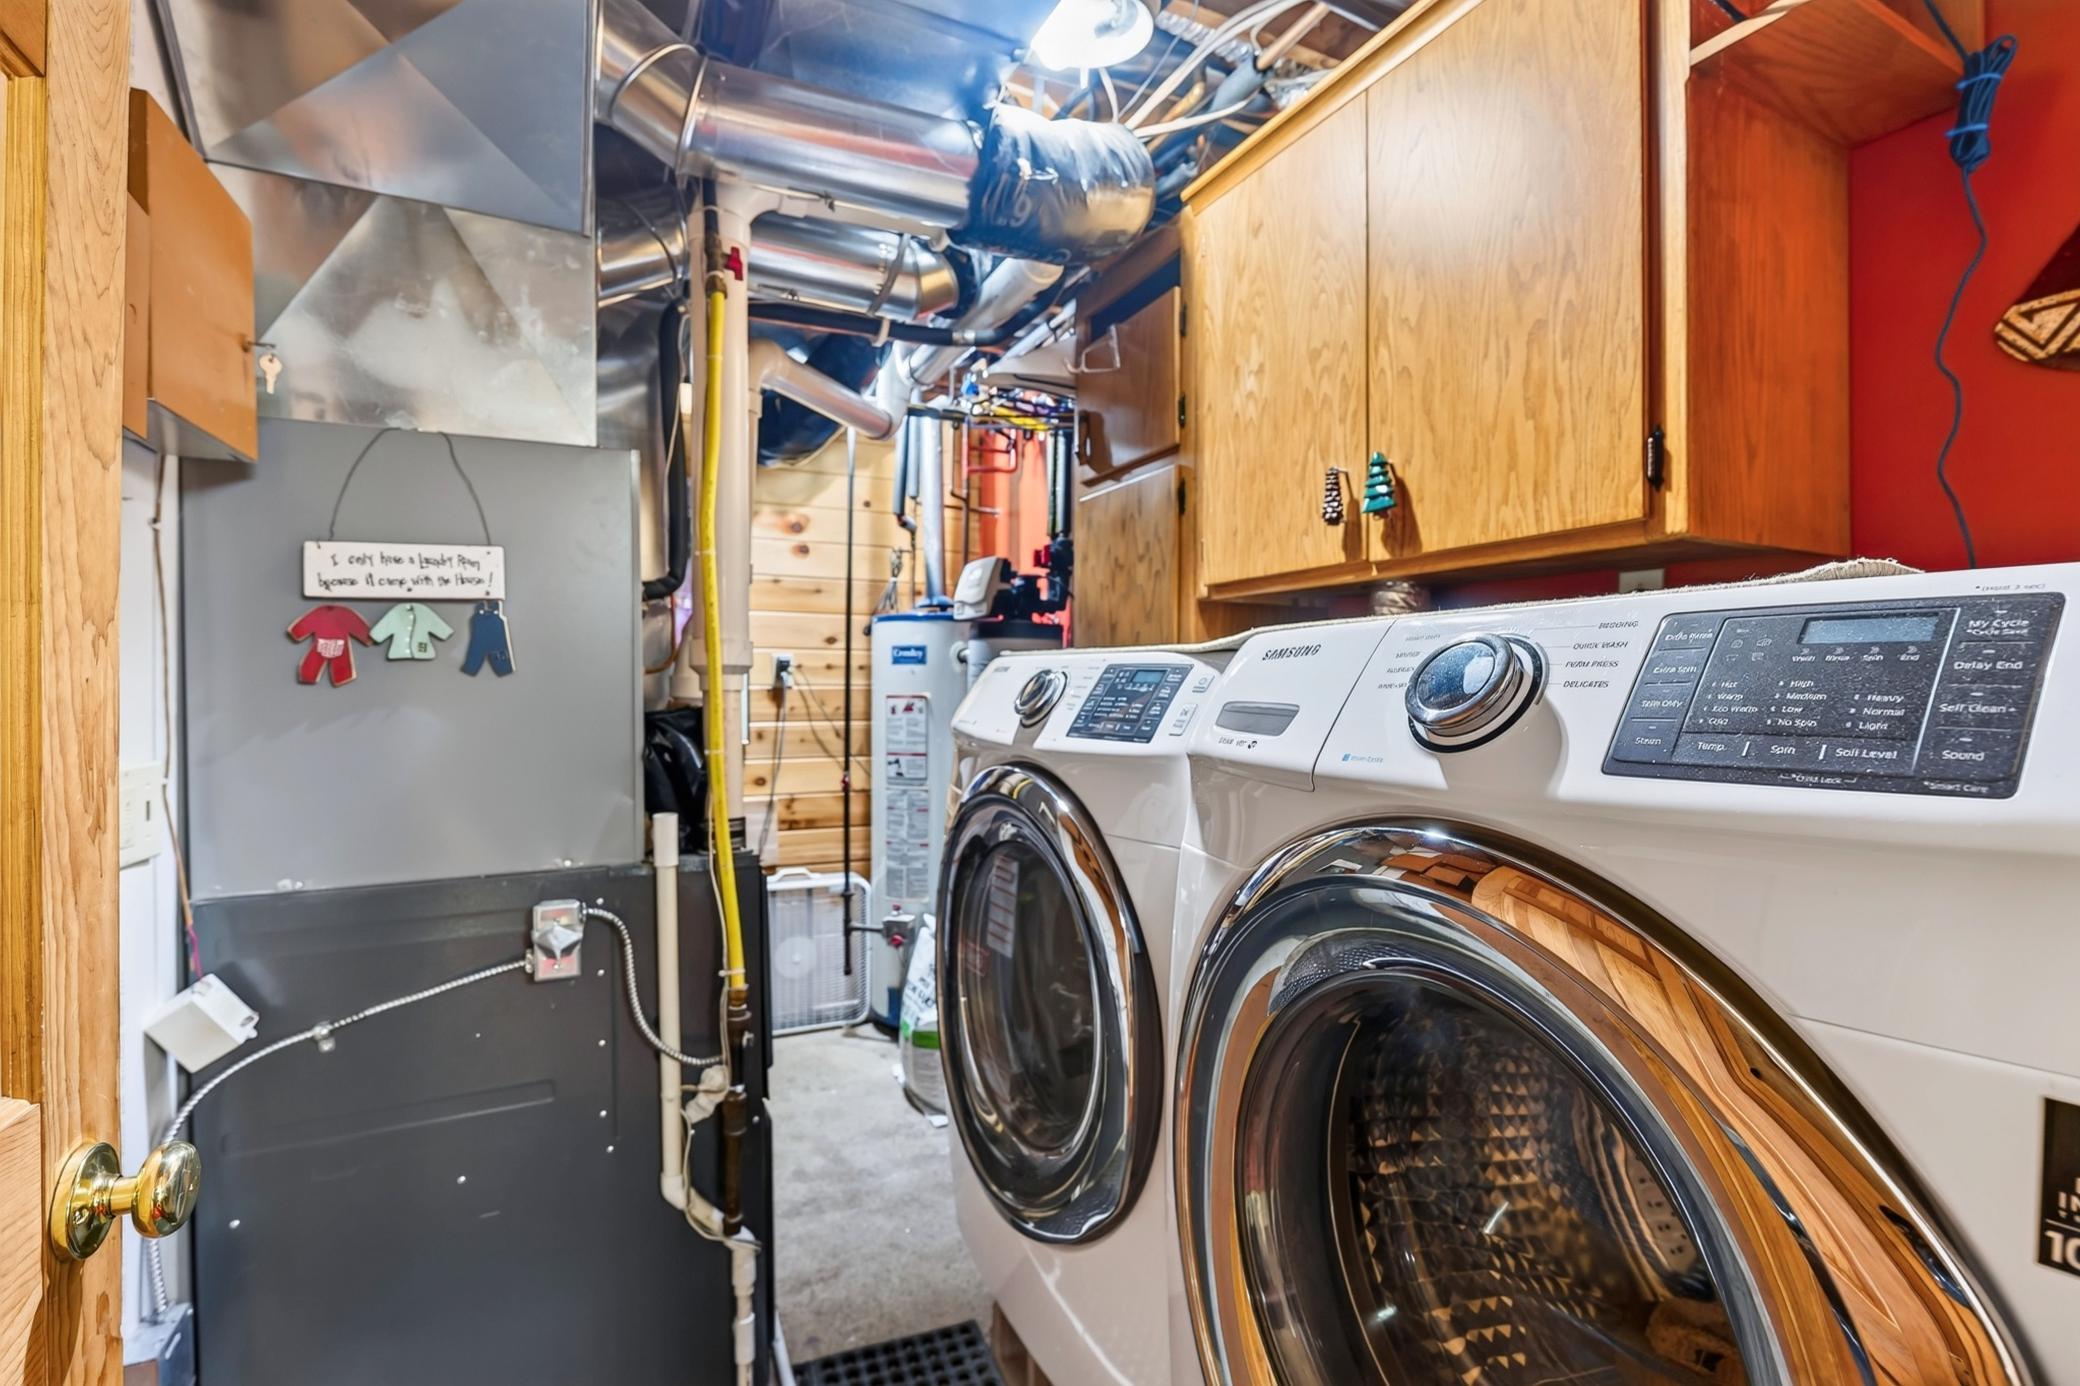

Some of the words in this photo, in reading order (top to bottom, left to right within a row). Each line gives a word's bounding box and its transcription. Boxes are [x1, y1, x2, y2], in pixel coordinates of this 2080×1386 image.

[348, 553, 374, 567] only
[380, 551, 405, 566] have
[418, 552, 453, 570] Laundry
[317, 572, 359, 592] because
[411, 574, 433, 587] with
[1968, 619, 1989, 630] My
[1992, 618, 2030, 630] Cycle
[1262, 644, 1322, 661] SAMSUNG
[1900, 654, 1920, 662] End
[1953, 660, 1993, 672] Delay
[1996, 660, 2024, 670] End
[1563, 680, 1610, 689] DELICATES
[1790, 680, 1815, 689] High
[1786, 692, 1828, 701] Medium
[1867, 694, 1905, 703] Heavy
[1782, 705, 1804, 714] Low
[1862, 706, 1906, 717] Normal
[1938, 703, 1964, 713] Self
[1777, 718, 1792, 727] No
[1794, 718, 1818, 728] Spin
[1859, 720, 1889, 732] Light
[1770, 744, 1797, 756] Spin
[1835, 747, 1859, 758] Soil
[1862, 748, 1898, 760] Level
[1942, 750, 1985, 762] Sound
